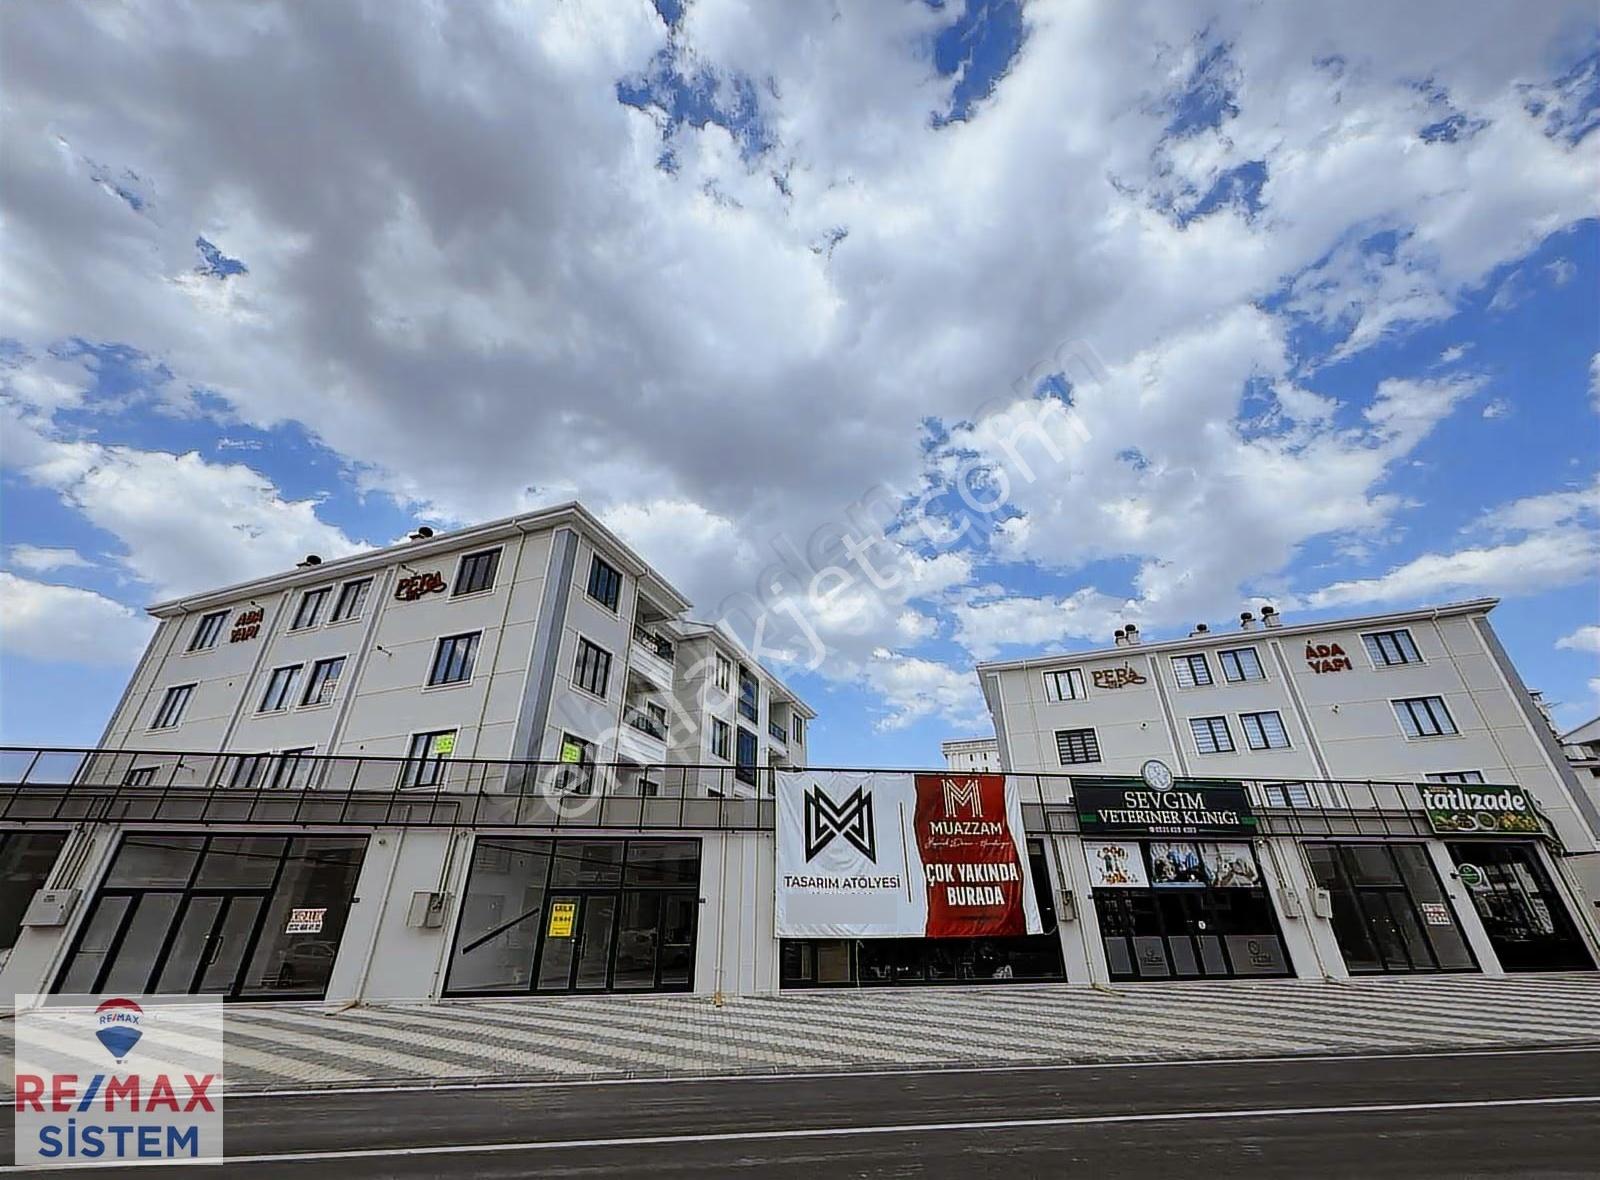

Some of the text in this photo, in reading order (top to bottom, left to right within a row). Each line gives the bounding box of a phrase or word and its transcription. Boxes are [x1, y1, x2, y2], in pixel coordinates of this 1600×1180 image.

[1306, 643, 1345, 659] ADA
[1308, 657, 1353, 674] YAPI
[1091, 667, 1147, 688] PERA
[1422, 788, 1527, 811] tatlızade
[929, 821, 1003, 835] MUAZZAM
[784, 874, 901, 889] TASARIM ATÖLYESİ
[926, 862, 1019, 887] ÇOK YAKINDA
[946, 886, 1006, 906] BURADA
